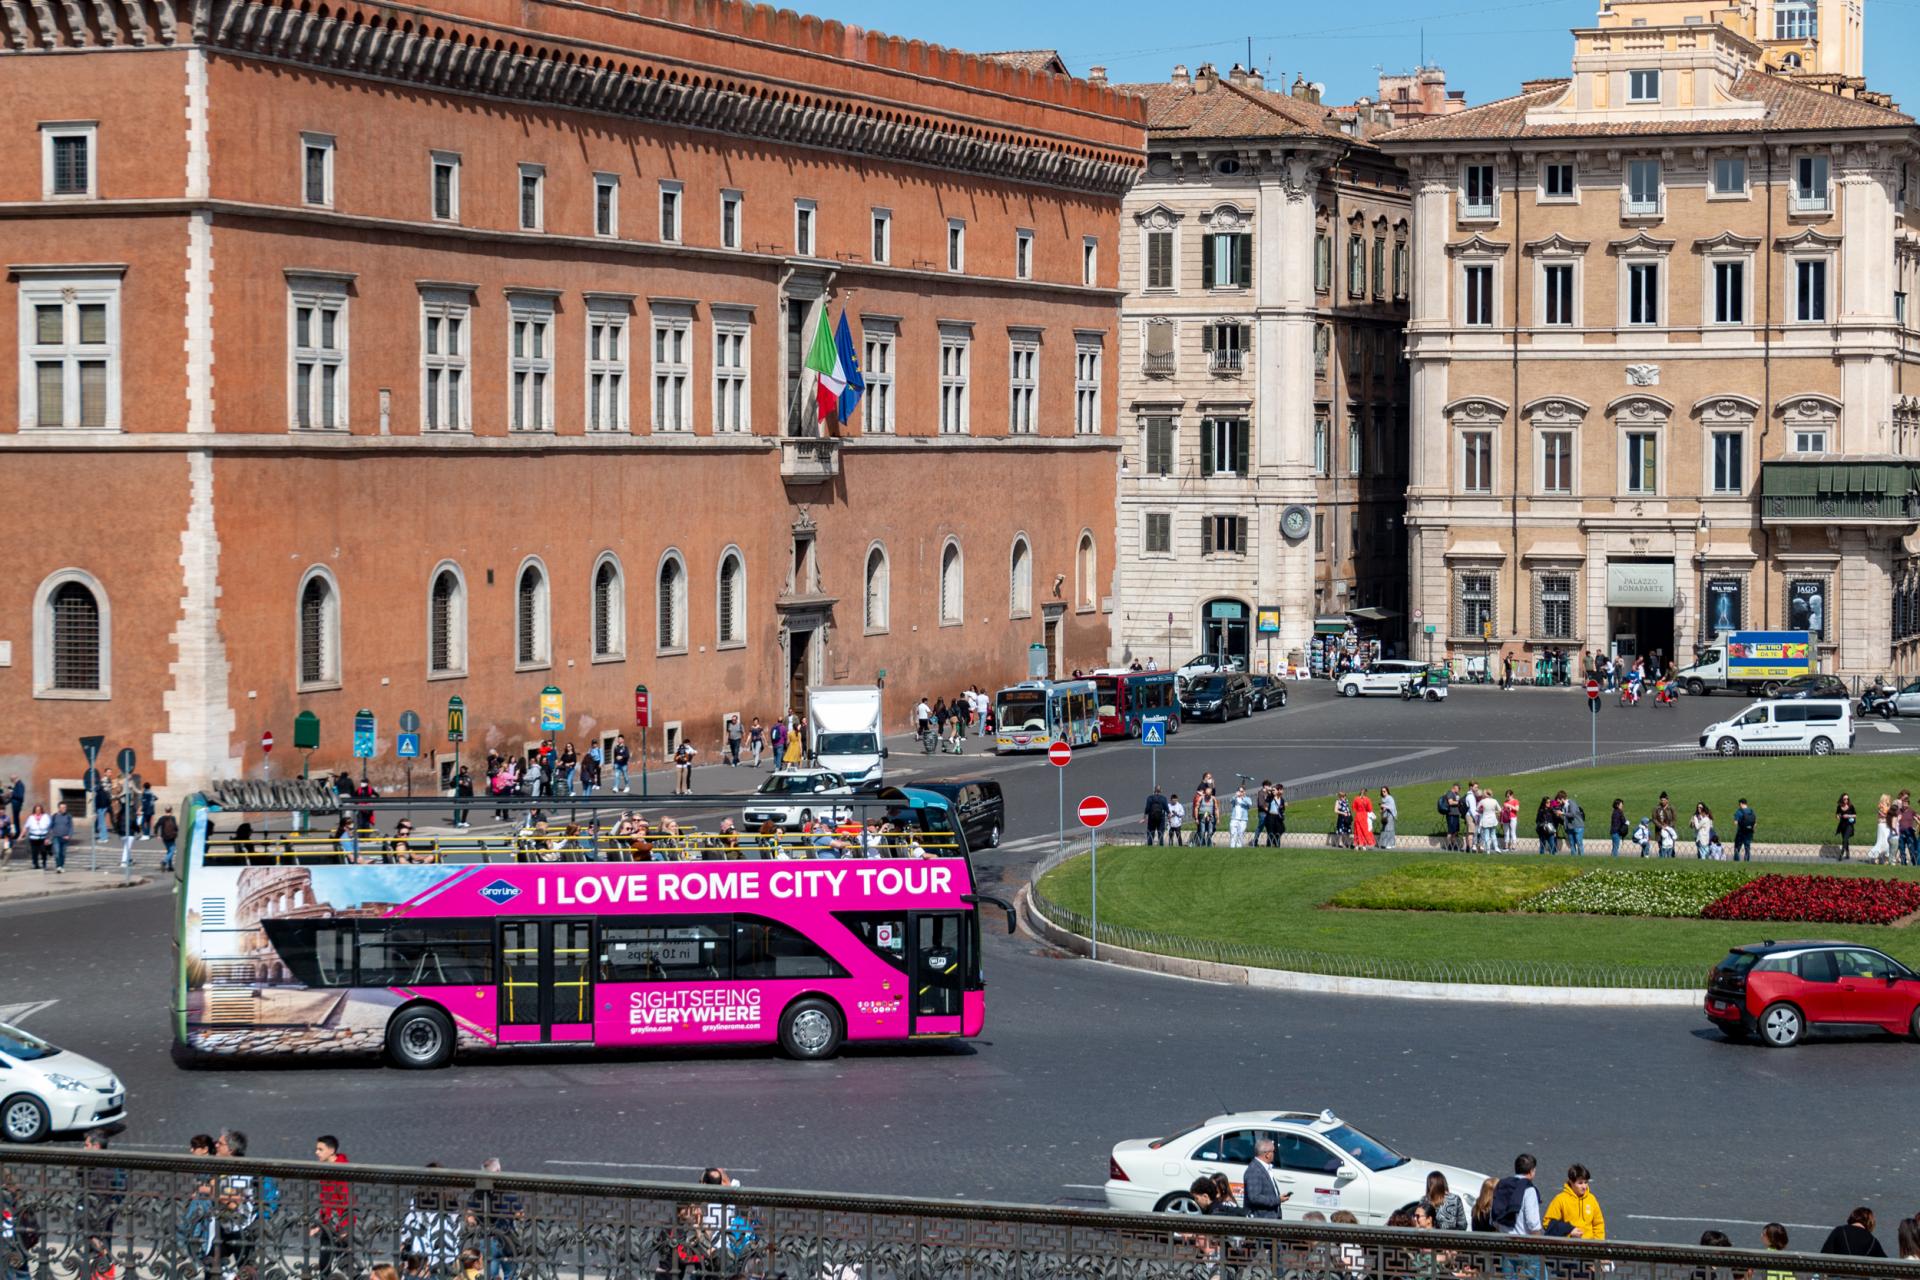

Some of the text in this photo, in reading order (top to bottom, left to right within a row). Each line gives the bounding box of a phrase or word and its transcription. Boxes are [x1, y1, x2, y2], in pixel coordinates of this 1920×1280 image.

[1624, 577, 1658, 585] PALAZZO
[1797, 585, 1818, 593] JAGO
[537, 867, 952, 905] I LOVE ROME CITY TOUR
[630, 988, 761, 1009] SIGHTSEEING
[630, 1005, 761, 1024] EVERYWHERE
[630, 1025, 672, 1035] grayline.com
[702, 1022, 760, 1032] graylinerome.com
